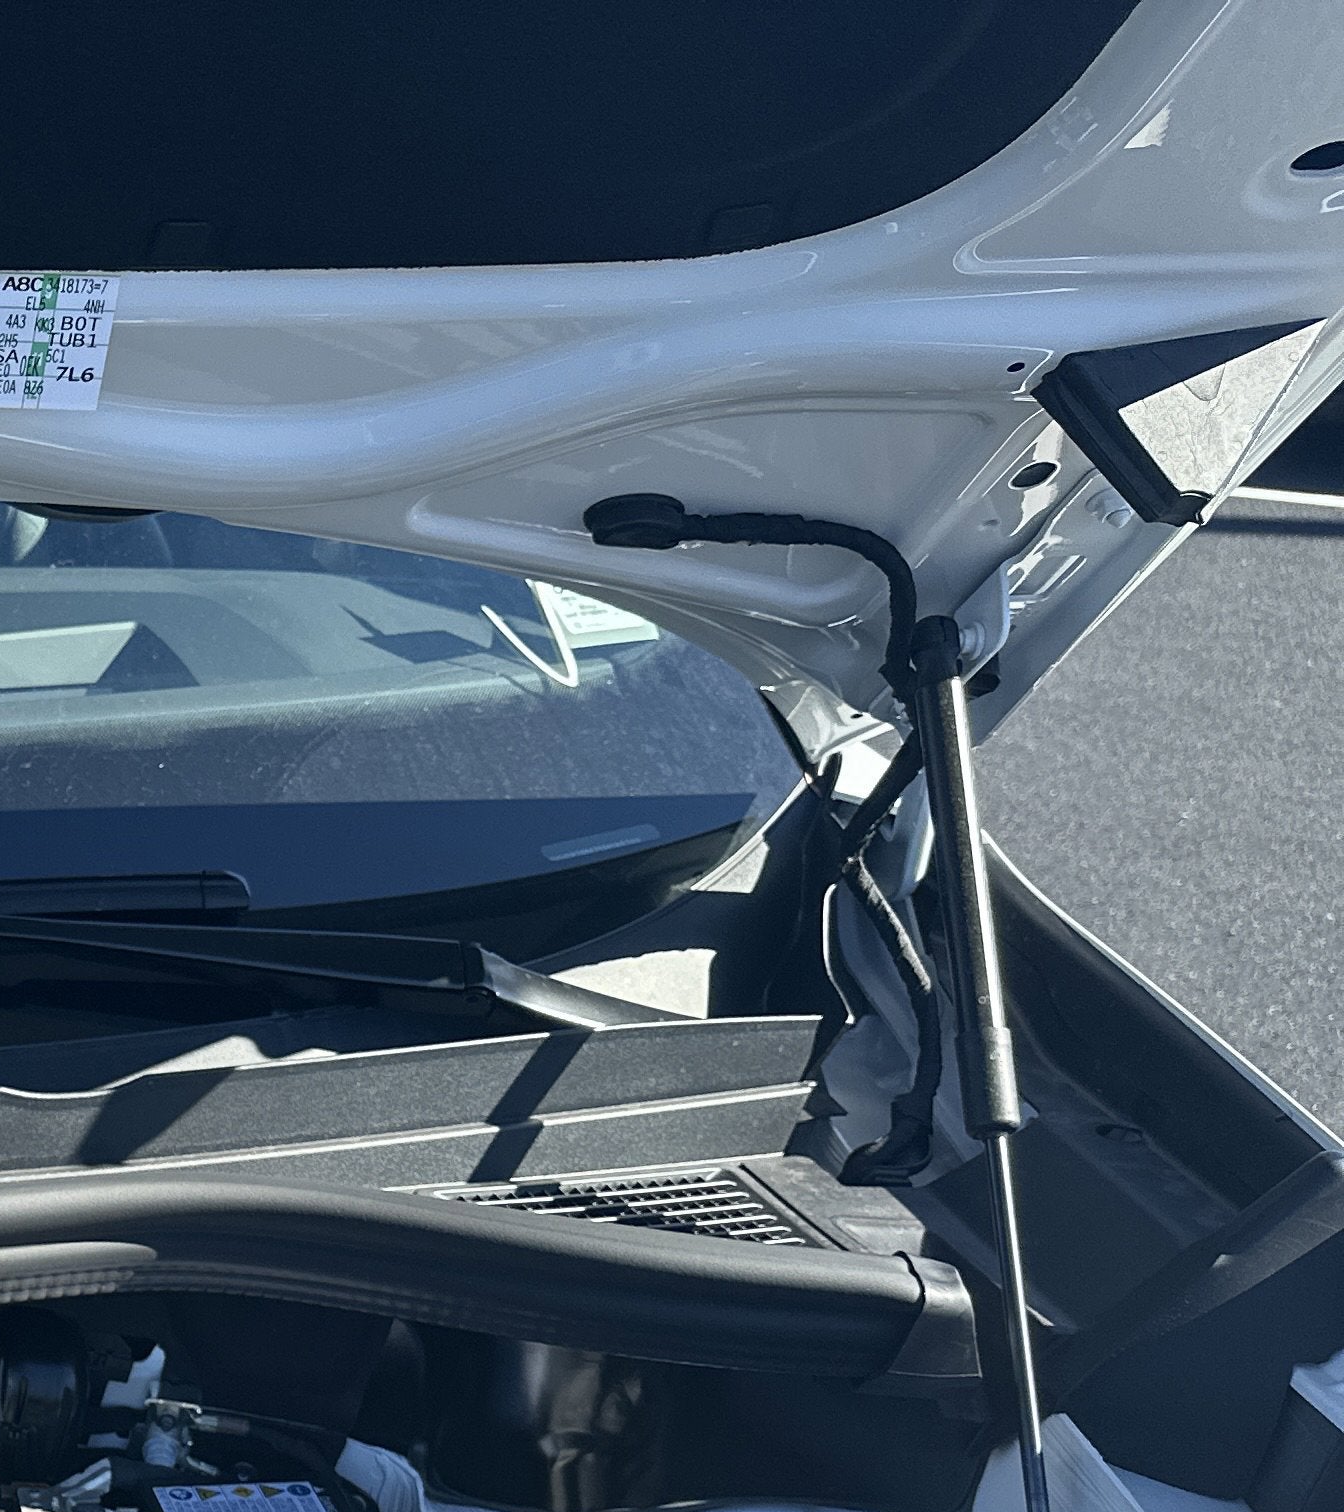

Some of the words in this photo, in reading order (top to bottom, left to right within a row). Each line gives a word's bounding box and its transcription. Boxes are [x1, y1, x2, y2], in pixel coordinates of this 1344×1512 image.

[2, 276, 44, 292] A8C
[25, 296, 46, 311] EL5
[5, 314, 27, 329] 4A3
[47, 331, 97, 348] TUB1
[46, 348, 66, 364] 5C1
[56, 366, 95, 382] 7L6
